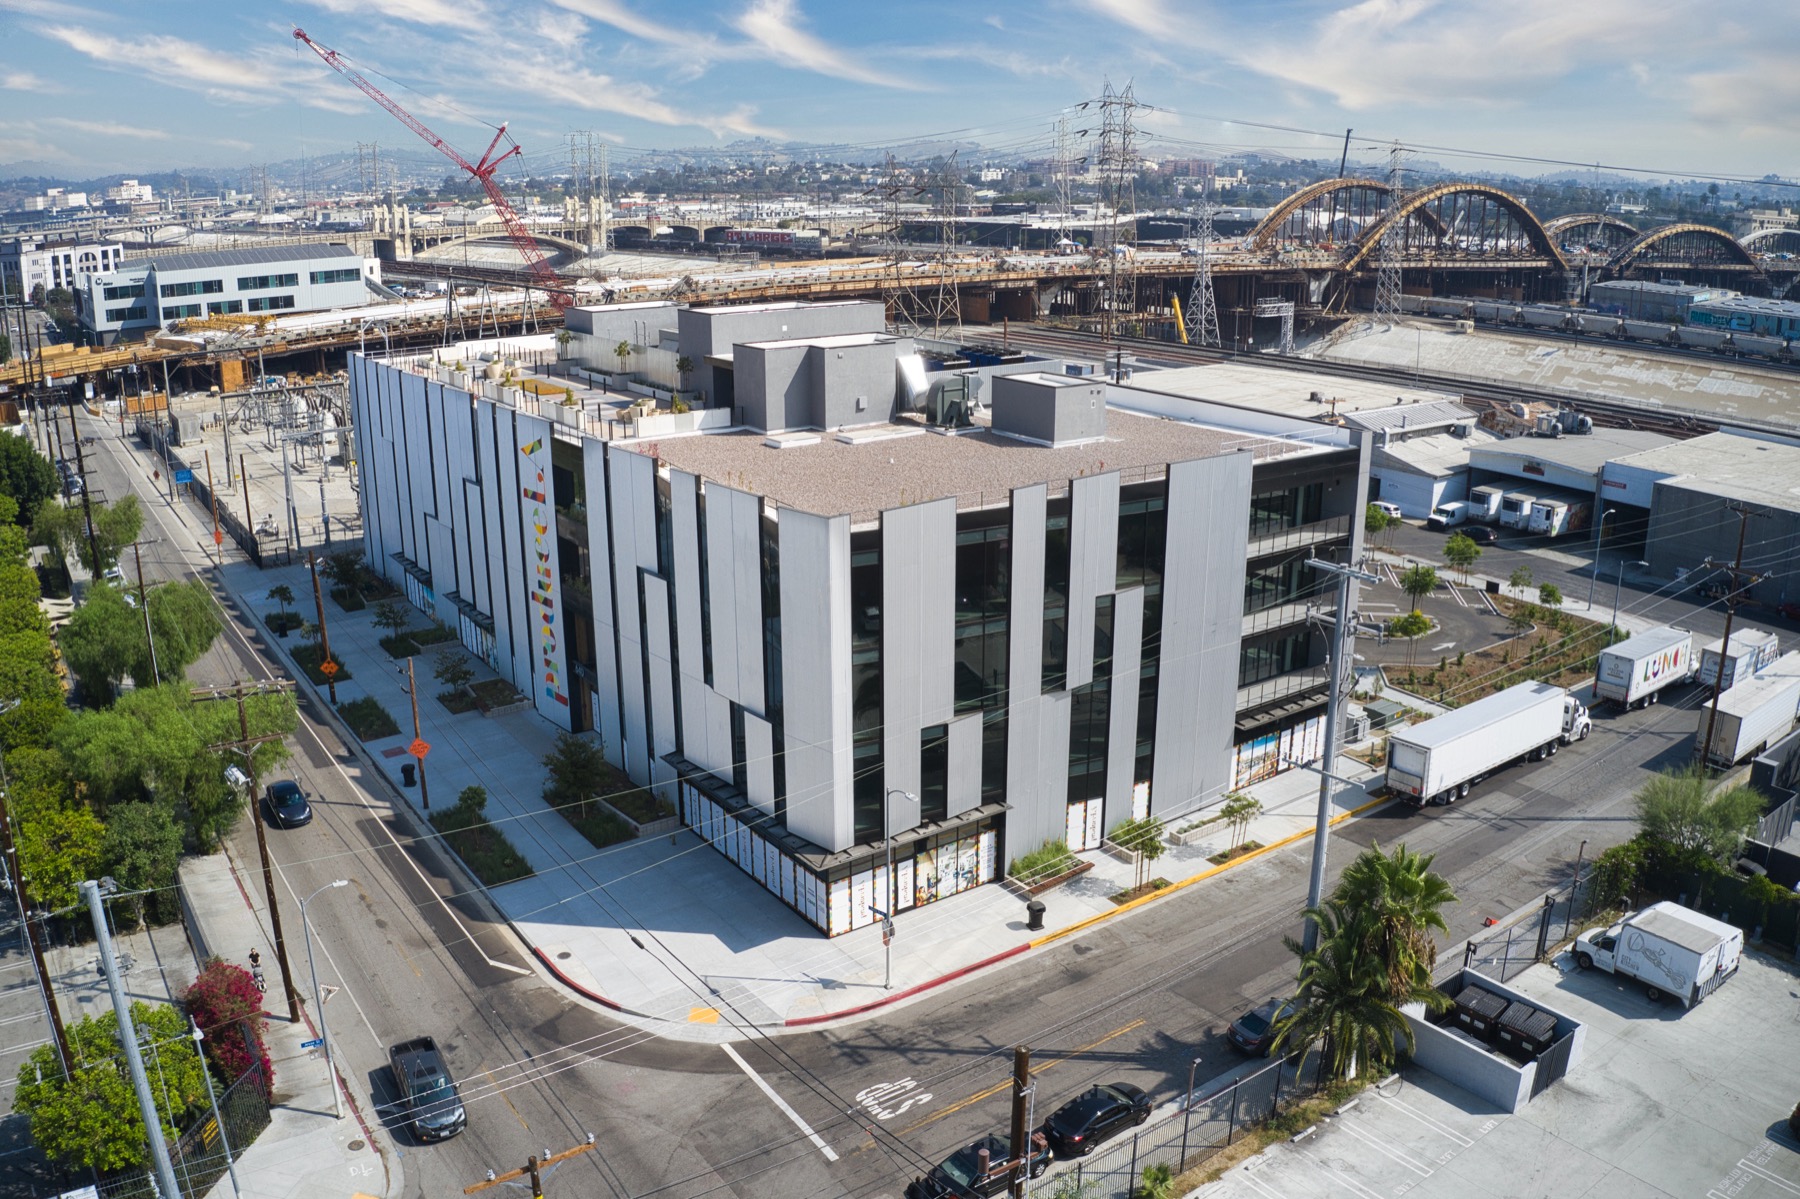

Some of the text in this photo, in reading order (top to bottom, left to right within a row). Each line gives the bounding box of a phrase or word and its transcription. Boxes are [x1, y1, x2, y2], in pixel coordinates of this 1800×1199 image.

[1644, 644, 1688, 682] LUNCH
[855, 1076, 934, 1120] STOP
[1478, 1119, 1499, 1134] LYFT
[1436, 1149, 1457, 1165] LYFT
[1393, 1179, 1415, 1196] LYFT
